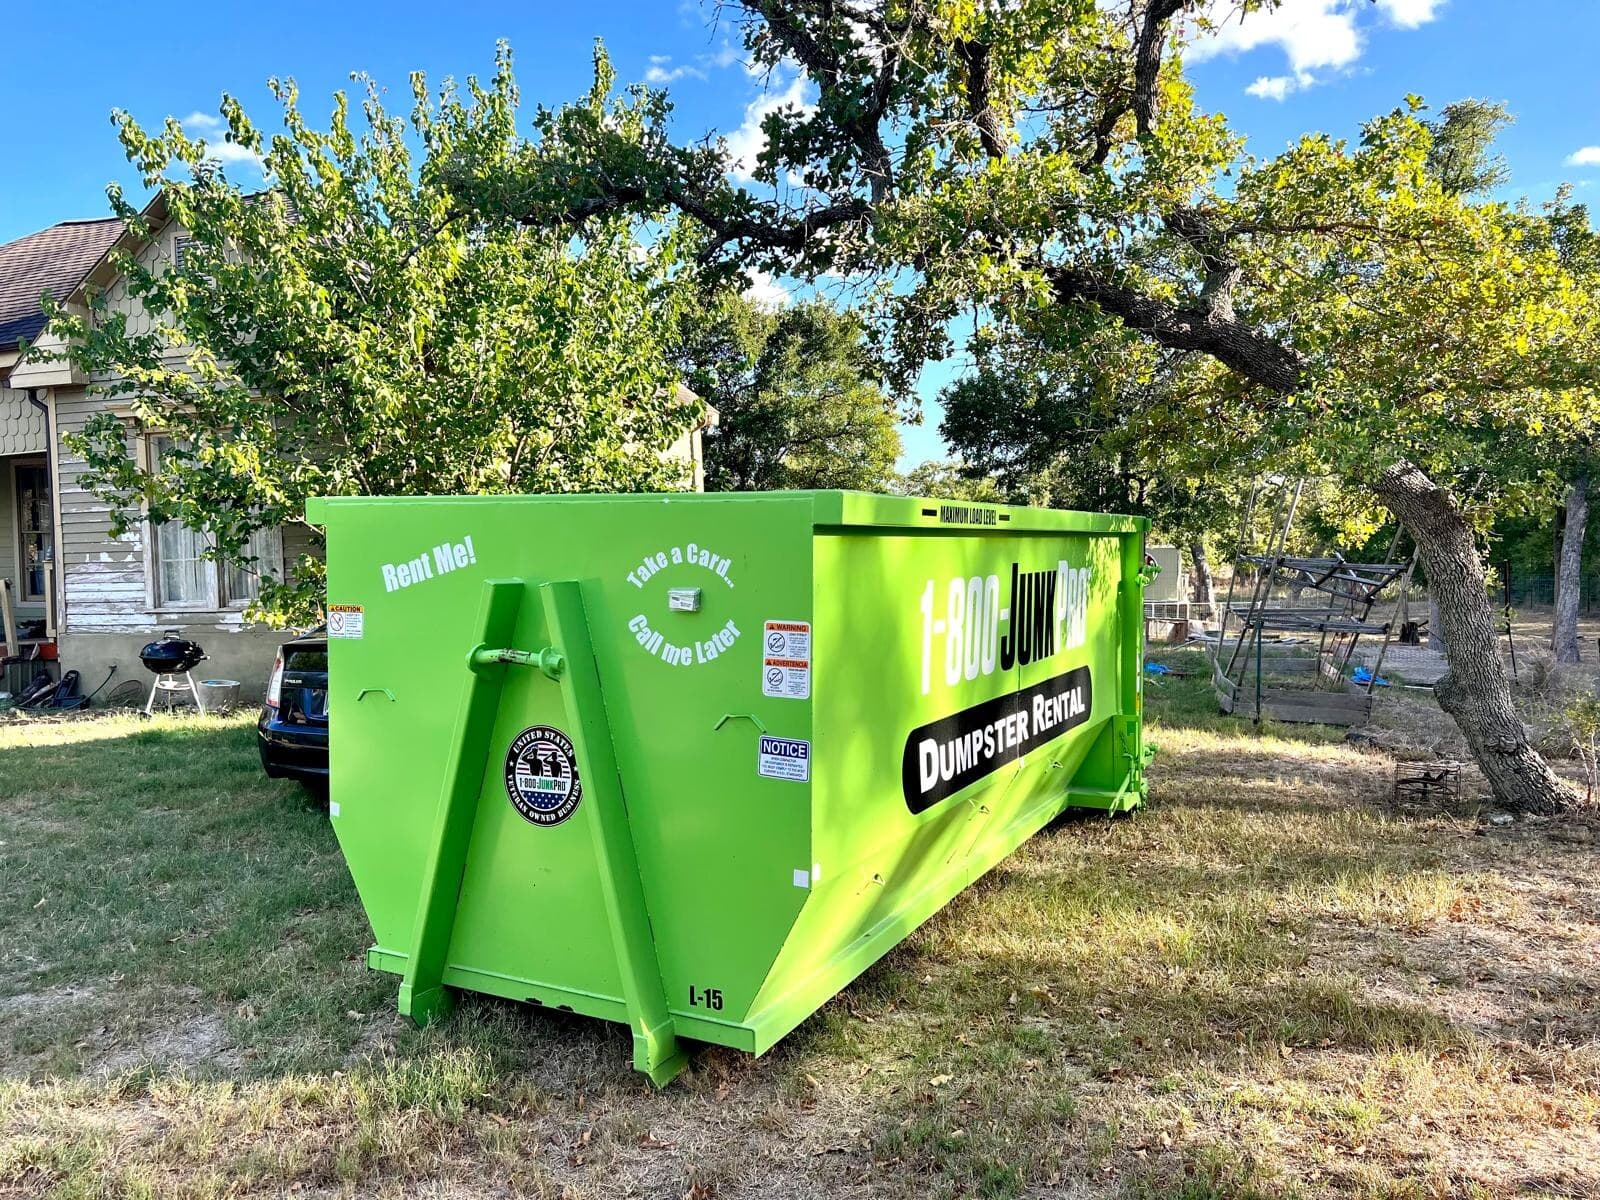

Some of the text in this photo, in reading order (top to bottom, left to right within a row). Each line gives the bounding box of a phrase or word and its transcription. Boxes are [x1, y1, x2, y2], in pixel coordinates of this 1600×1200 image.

[940, 505, 997, 526] MAXIMUM LOAD LEVEL
[381, 535, 477, 593] Rent Me!
[626, 543, 735, 589] Take a Card...
[335, 605, 361, 613] CAUTION
[628, 614, 664, 656] Call
[660, 642, 693, 666] me
[695, 618, 741, 664] Later
[776, 623, 806, 632] WARNING
[772, 659, 807, 668] ADVERTENCIA
[513, 730, 574, 757] UNITED STATES
[763, 740, 806, 758] NOTICE
[918, 686, 1086, 794] DUMPSTER RENTAL
[507, 774, 581, 821] VETERAN OWNED BUSINESS
[689, 985, 723, 1011] L-15
